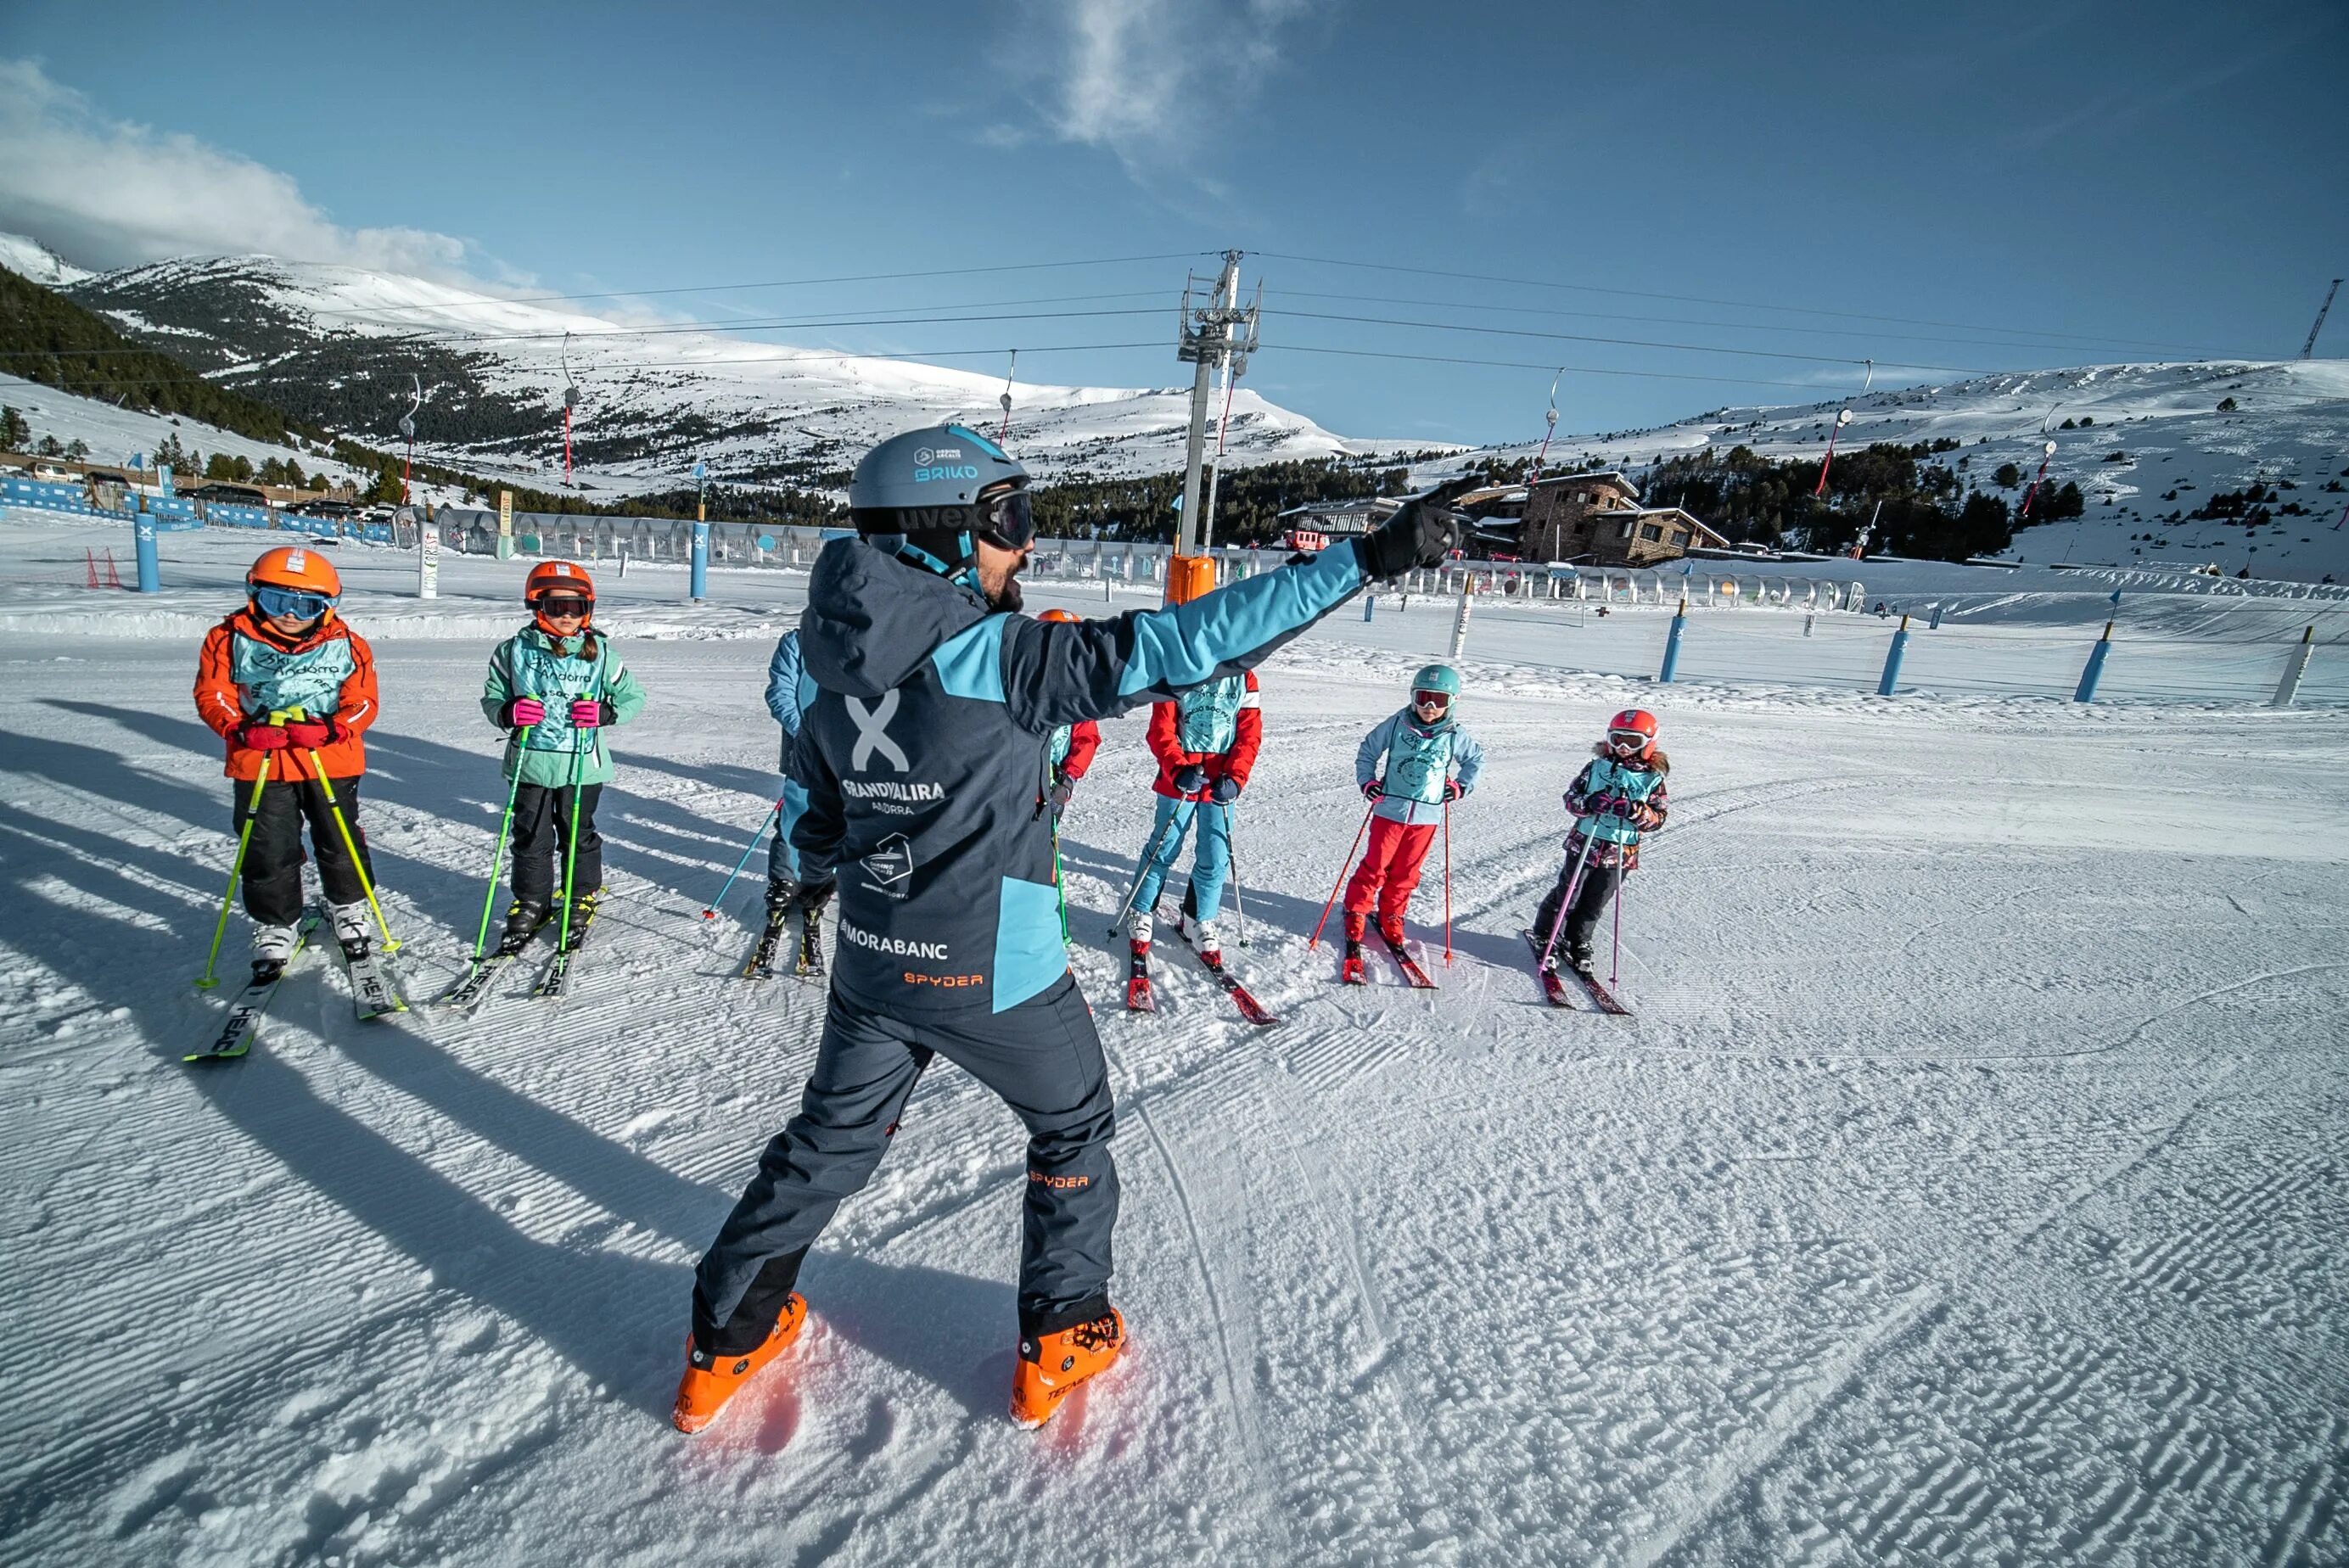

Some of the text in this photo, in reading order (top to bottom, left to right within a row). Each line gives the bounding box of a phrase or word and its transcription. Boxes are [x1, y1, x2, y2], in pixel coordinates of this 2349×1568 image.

[915, 465, 978, 482] BRIKO
[897, 507, 984, 529] uvex
[273, 664, 340, 677] Andorra
[540, 669, 592, 683] Andorra
[847, 924, 949, 960] MORABANC
[904, 972, 984, 988] SPYDER
[212, 1005, 257, 1052] HEAD
[1030, 1171, 1089, 1189] SPYDER
